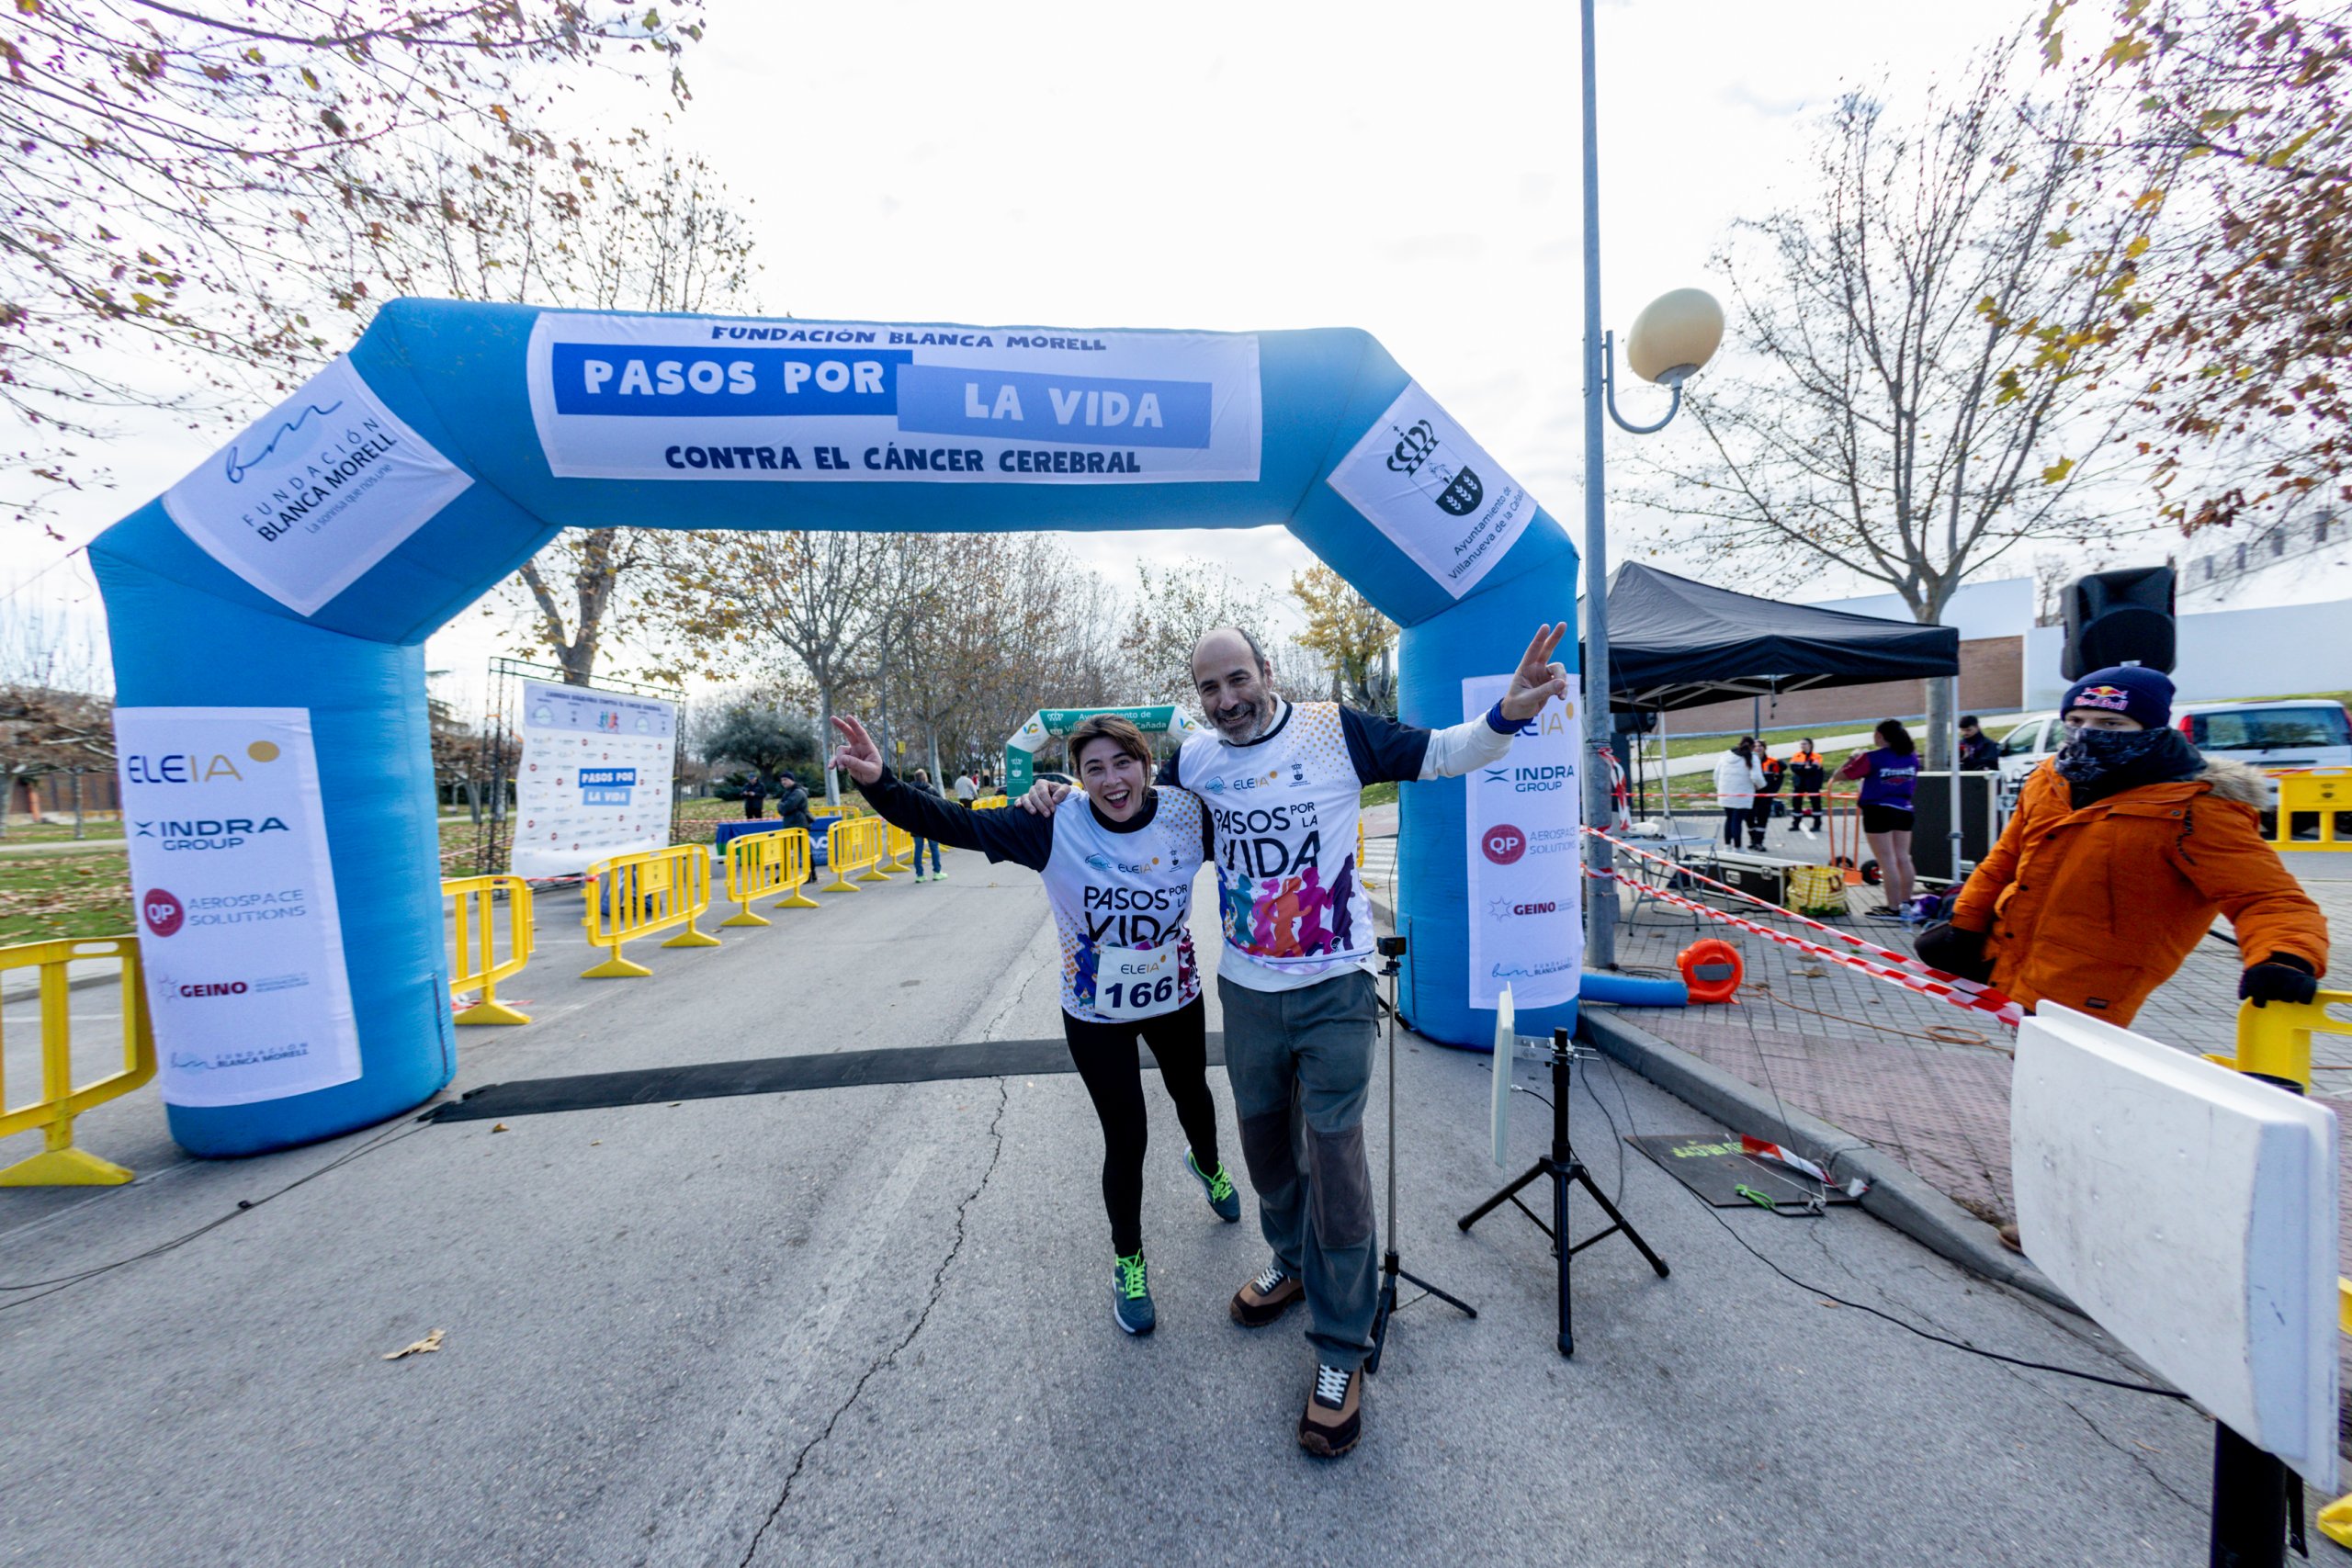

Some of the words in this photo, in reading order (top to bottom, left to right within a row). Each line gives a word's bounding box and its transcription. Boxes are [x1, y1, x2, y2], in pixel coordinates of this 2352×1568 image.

[711, 325, 876, 343] FUNDACIÓN
[888, 329, 993, 349] BLANCA
[1005, 334, 1107, 352] MORELL
[583, 359, 755, 396] PASOS
[785, 361, 885, 395] POR
[964, 382, 1023, 421] LA
[1047, 387, 1164, 429] VIDA
[665, 446, 802, 472] CONTRA
[815, 446, 850, 472] EL
[864, 440, 984, 473] CÁNCER
[998, 450, 1141, 475] CEREBRAL
[242, 418, 379, 528] FUNDACIÓN
[257, 485, 330, 542] BLANCA
[324, 433, 397, 491] MORELL
[305, 520, 320, 534] La
[344, 485, 363, 504] que
[375, 463, 393, 482] une
[1454, 495, 1506, 556] Ayuntamiento
[1503, 486, 1511, 497] de
[1448, 533, 1496, 579] Villanueva
[1495, 520, 1507, 533] de
[1504, 511, 1513, 520] la
[2073, 695, 2099, 706] Red
[2098, 697, 2129, 711] Bull
[1136, 721, 1167, 729] Cañada
[129, 754, 243, 783] ELEIA
[582, 773, 613, 783] PASOS
[616, 772, 634, 782] POR
[1516, 765, 1574, 781] INDRA
[1233, 777, 1270, 790] ELEIA
[1516, 782, 1562, 792] GROUP
[588, 792, 601, 802] LA
[605, 792, 627, 802] VIDA
[161, 817, 289, 837] INDRA
[1215, 807, 1291, 834] PASOS
[1290, 802, 1316, 815] POR
[1302, 815, 1318, 828] LA
[163, 838, 244, 851] GROUP
[1222, 830, 1320, 878] VIDA
[1489, 837, 1519, 854] QP
[1118, 863, 1152, 874] ELEIA
[188, 890, 304, 909] AEROSPACE
[1084, 886, 1170, 910] PASOS
[1169, 884, 1188, 897] POR
[147, 903, 175, 924] QP
[189, 906, 306, 926] SOLUTIONS
[1513, 901, 1555, 916] GEINO
[1085, 908, 1185, 946] VIDA
[1121, 961, 1159, 975] ELEIA
[1534, 967, 1556, 976] BLANCA
[180, 981, 248, 998] GEINO
[1104, 976, 1173, 1009] 166
